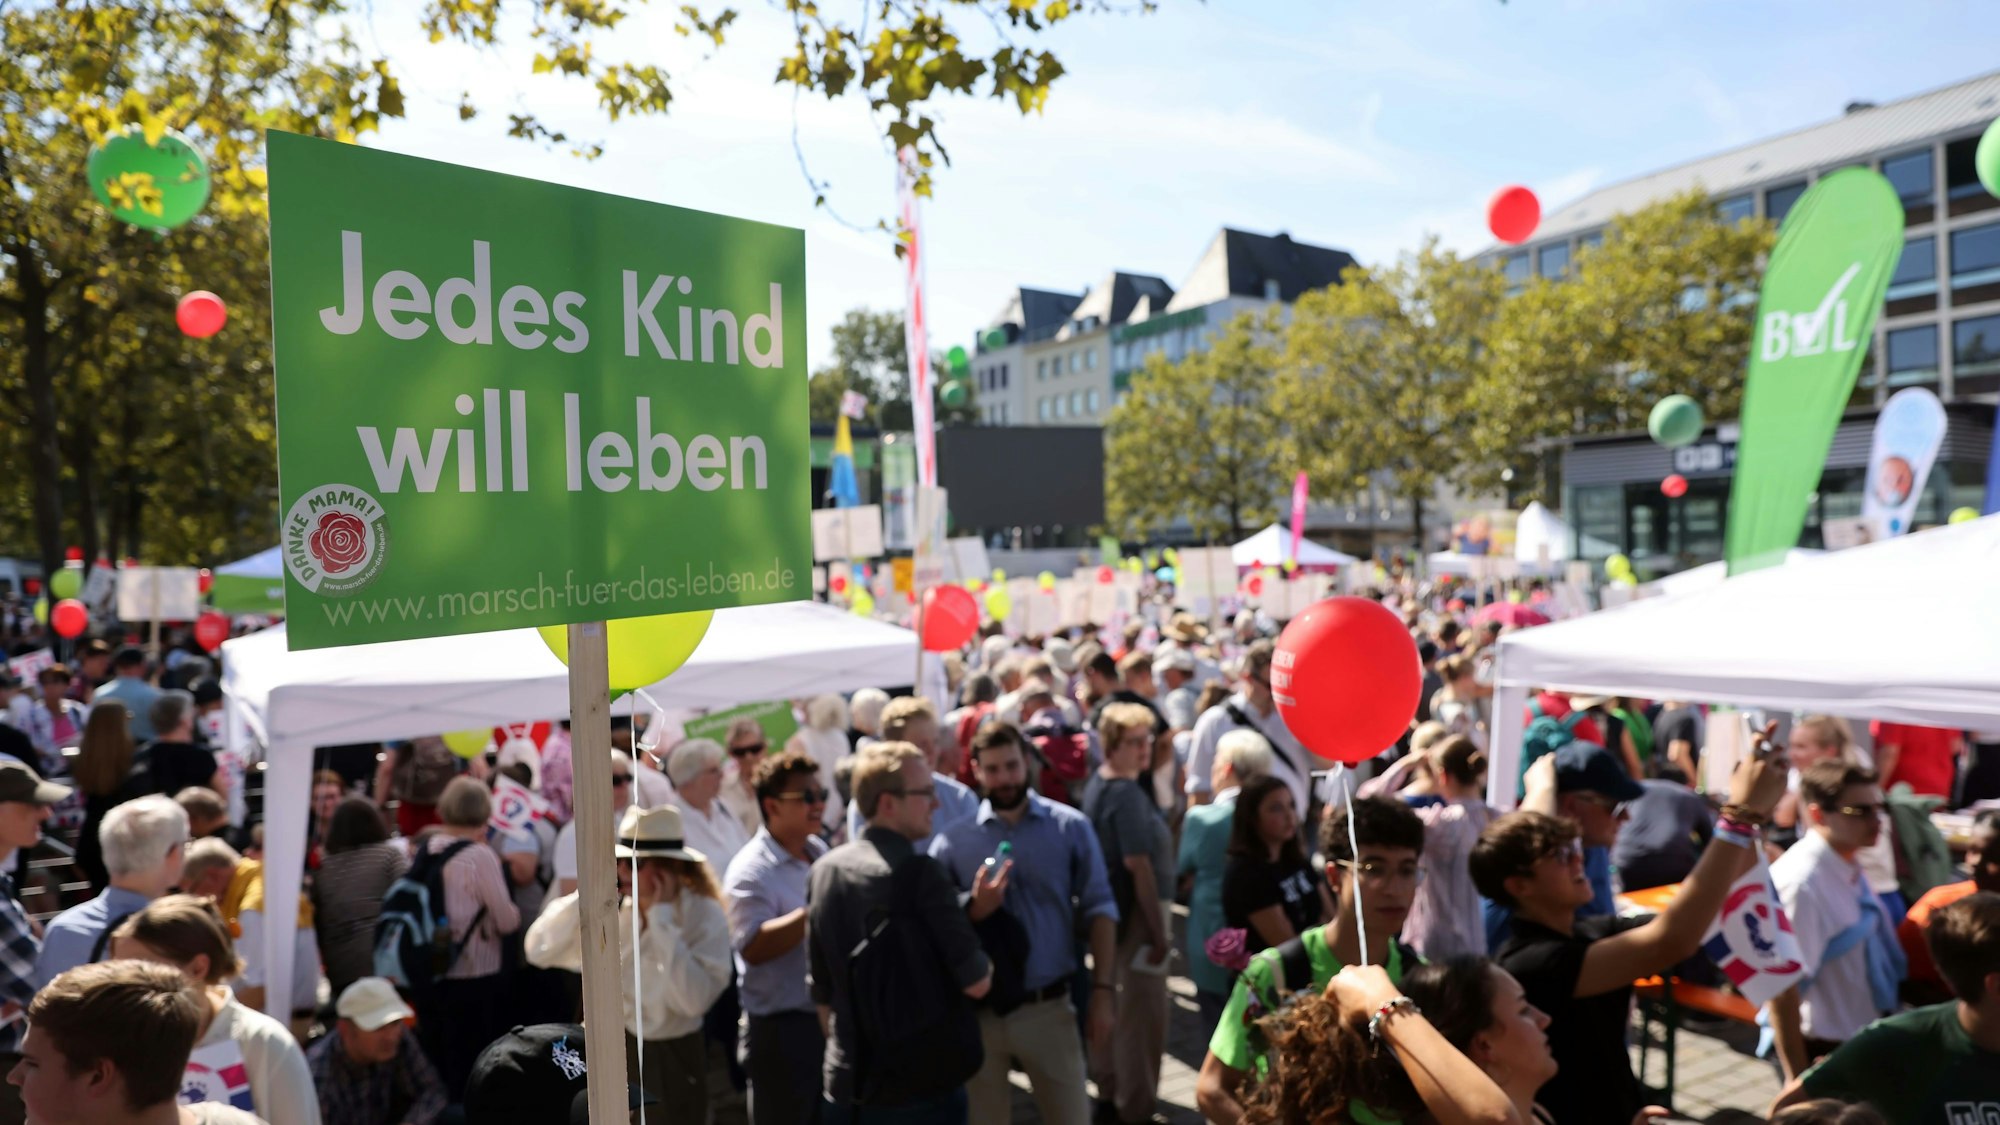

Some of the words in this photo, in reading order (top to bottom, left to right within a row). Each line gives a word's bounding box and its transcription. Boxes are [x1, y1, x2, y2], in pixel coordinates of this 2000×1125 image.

[319, 230, 589, 353] Jedes
[622, 269, 784, 369] Kind
[356, 388, 529, 494] will
[564, 392, 768, 493] leben
[288, 513, 317, 582] DANKE
[308, 490, 376, 517] MAMA!
[323, 522, 385, 591] www.marsch-fuer-das-leben.de
[321, 556, 795, 628] www.marsch-fuer-das-leben.de
